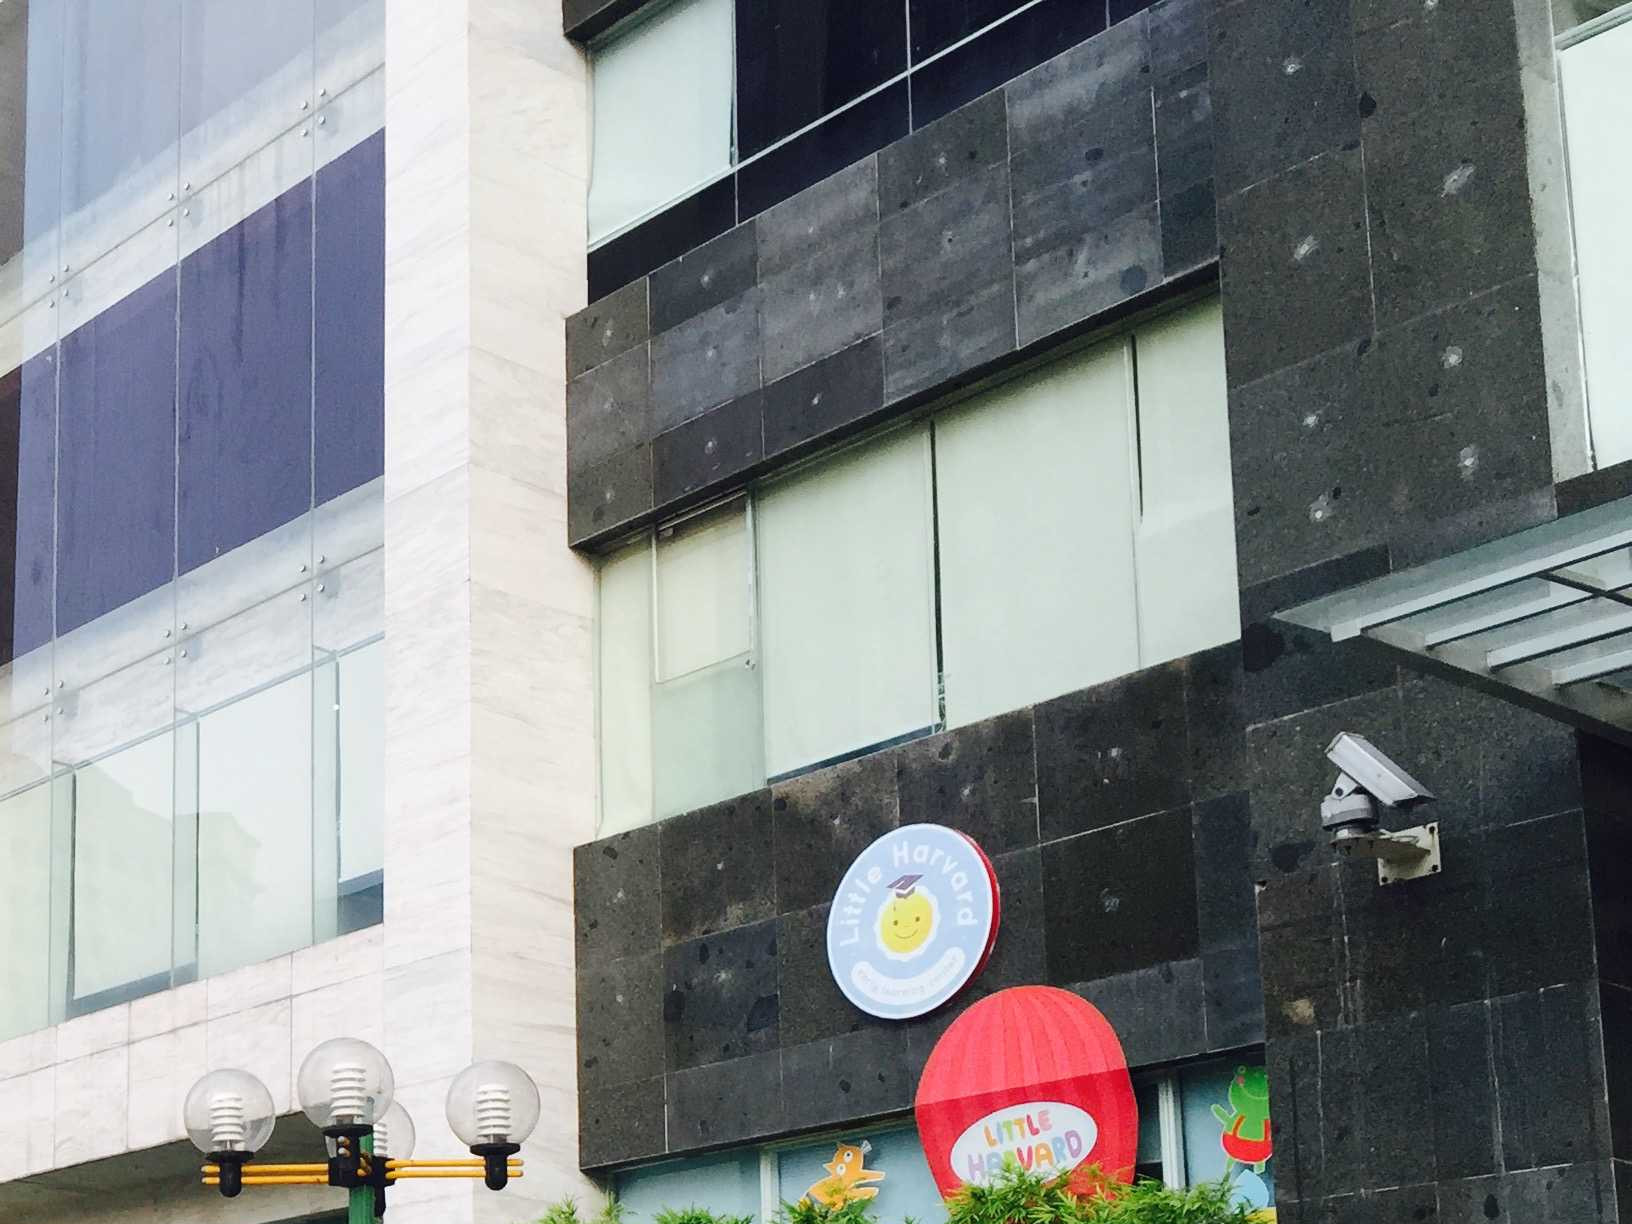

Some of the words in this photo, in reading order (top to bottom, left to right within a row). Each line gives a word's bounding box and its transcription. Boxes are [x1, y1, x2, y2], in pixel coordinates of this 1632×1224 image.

[839, 866, 883, 947] Little
[892, 840, 979, 927] Harvard
[983, 1109, 1053, 1148] LITTLE
